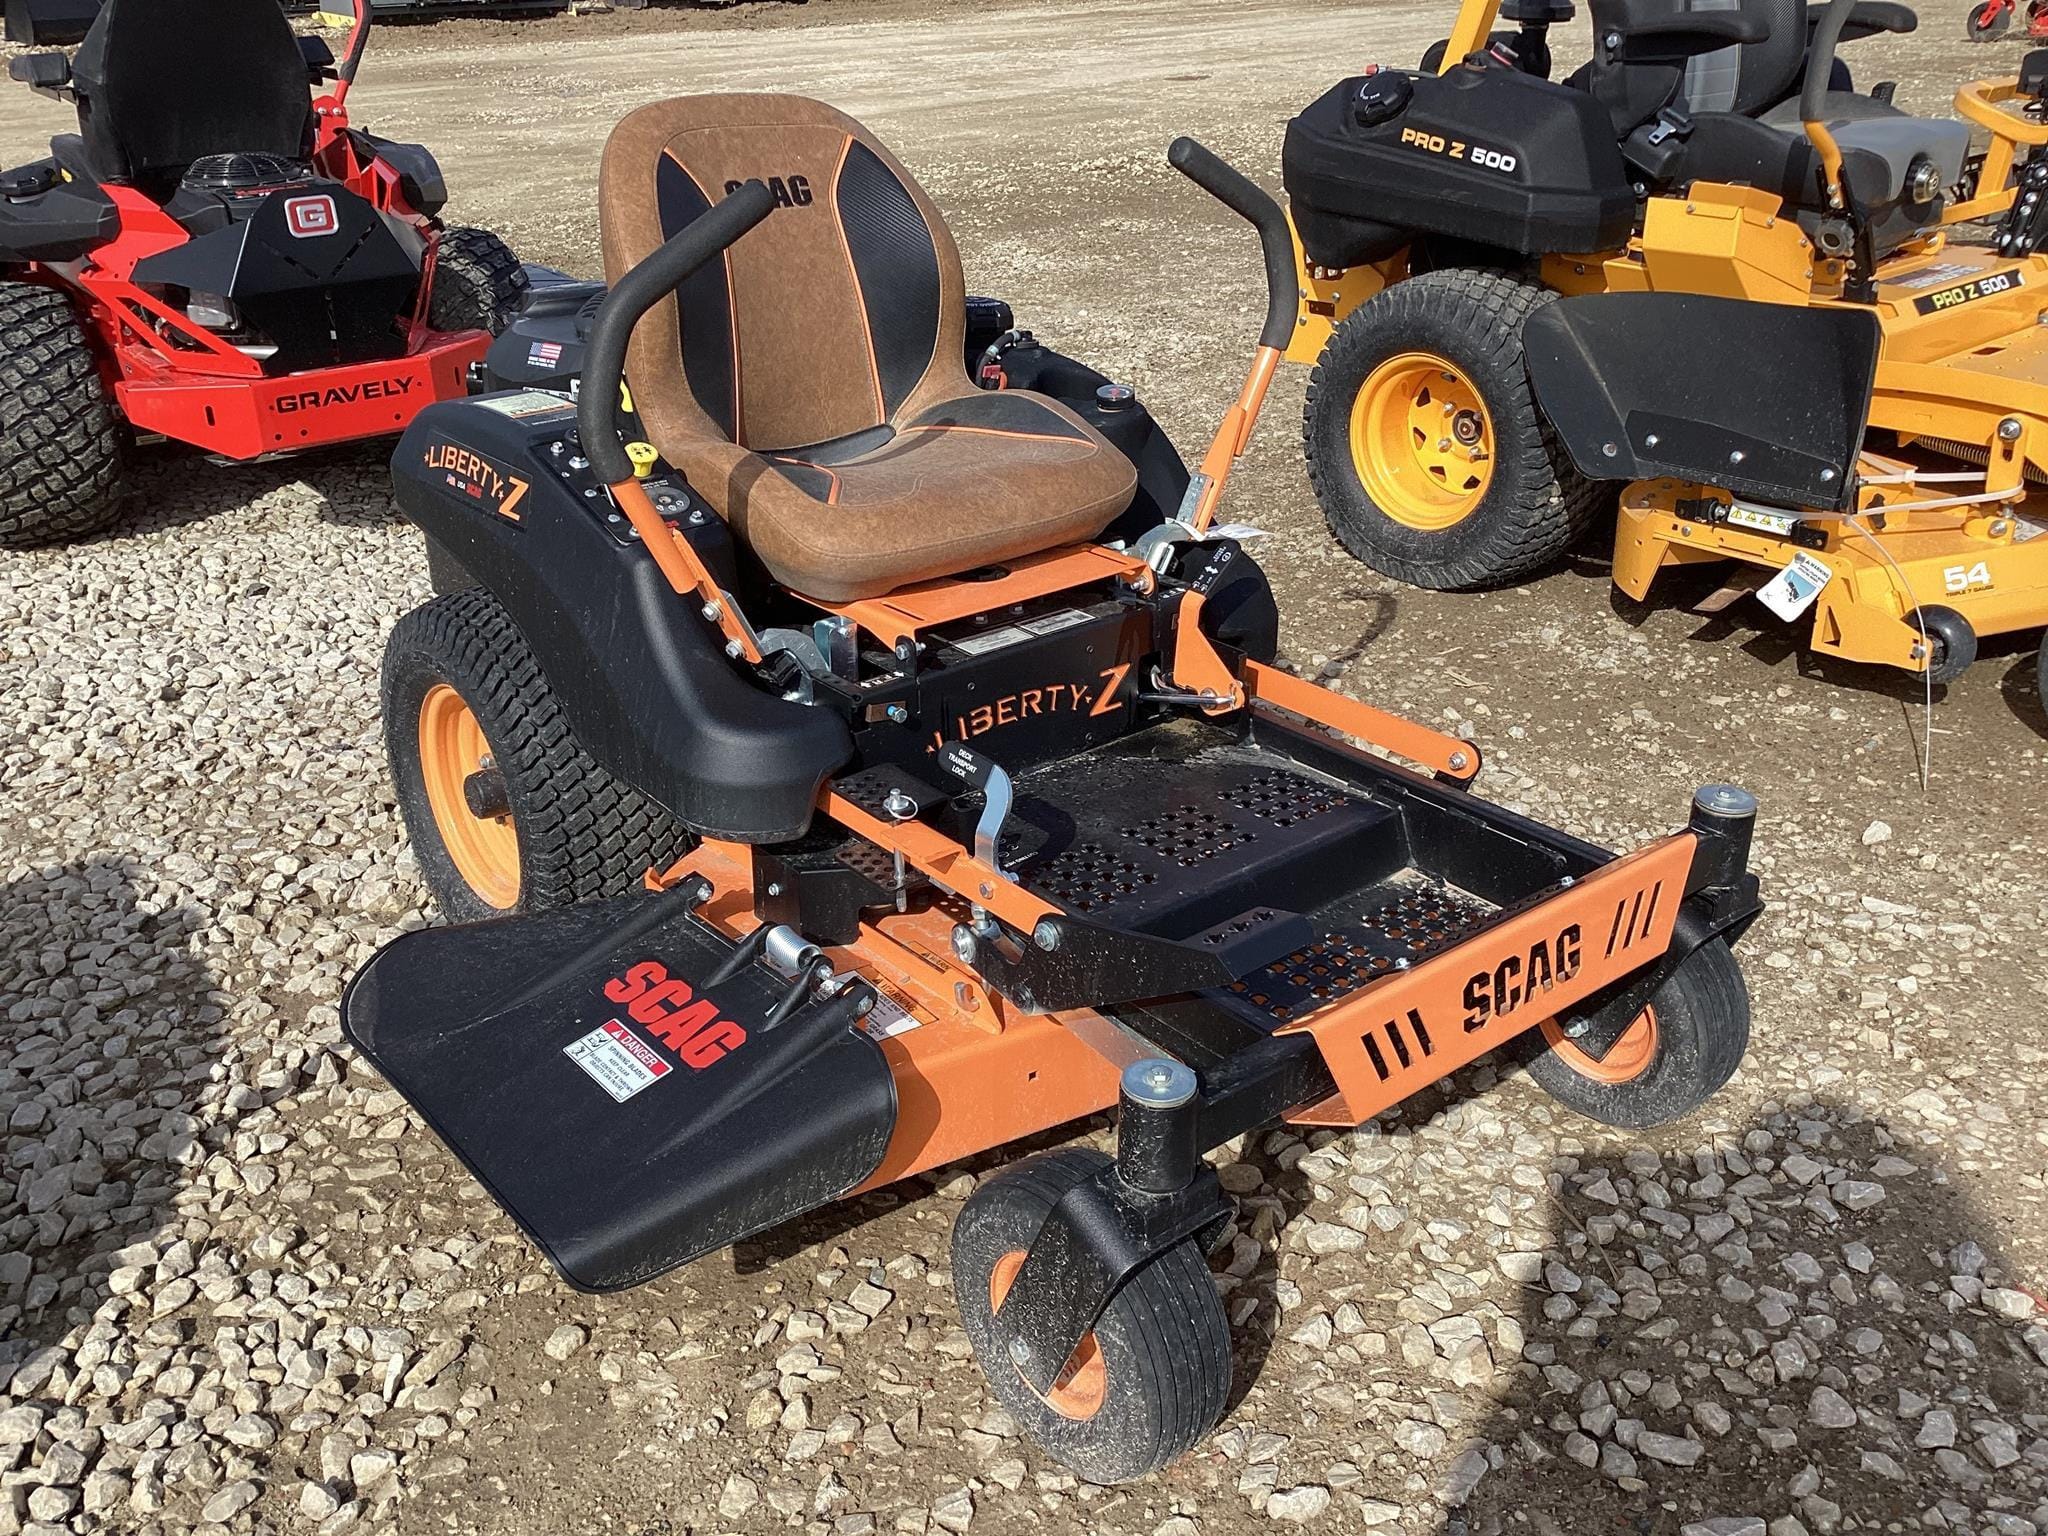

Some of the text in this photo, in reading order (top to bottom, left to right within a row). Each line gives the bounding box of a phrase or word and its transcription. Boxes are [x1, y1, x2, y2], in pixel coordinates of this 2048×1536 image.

[1401, 127, 1517, 172] PRO Z 500
[724, 175, 813, 208] AG
[1931, 287, 1966, 309] PRO
[1965, 284, 1980, 299] Z
[1979, 275, 2010, 295] 500
[275, 376, 414, 414] GRAVELY
[428, 445, 529, 521] LIBERTY Z
[1943, 560, 1991, 592] 54
[1089, 663, 1131, 717] Z
[948, 752, 977, 774] TRANSPORT
[951, 765, 967, 778] LOCK
[958, 749, 974, 761] DECK
[1463, 923, 1581, 1034] SCAG
[603, 961, 747, 1068] SCAG
[608, 1046, 648, 1080] SPINNING BLADES
[620, 1036, 659, 1068] DANGER
